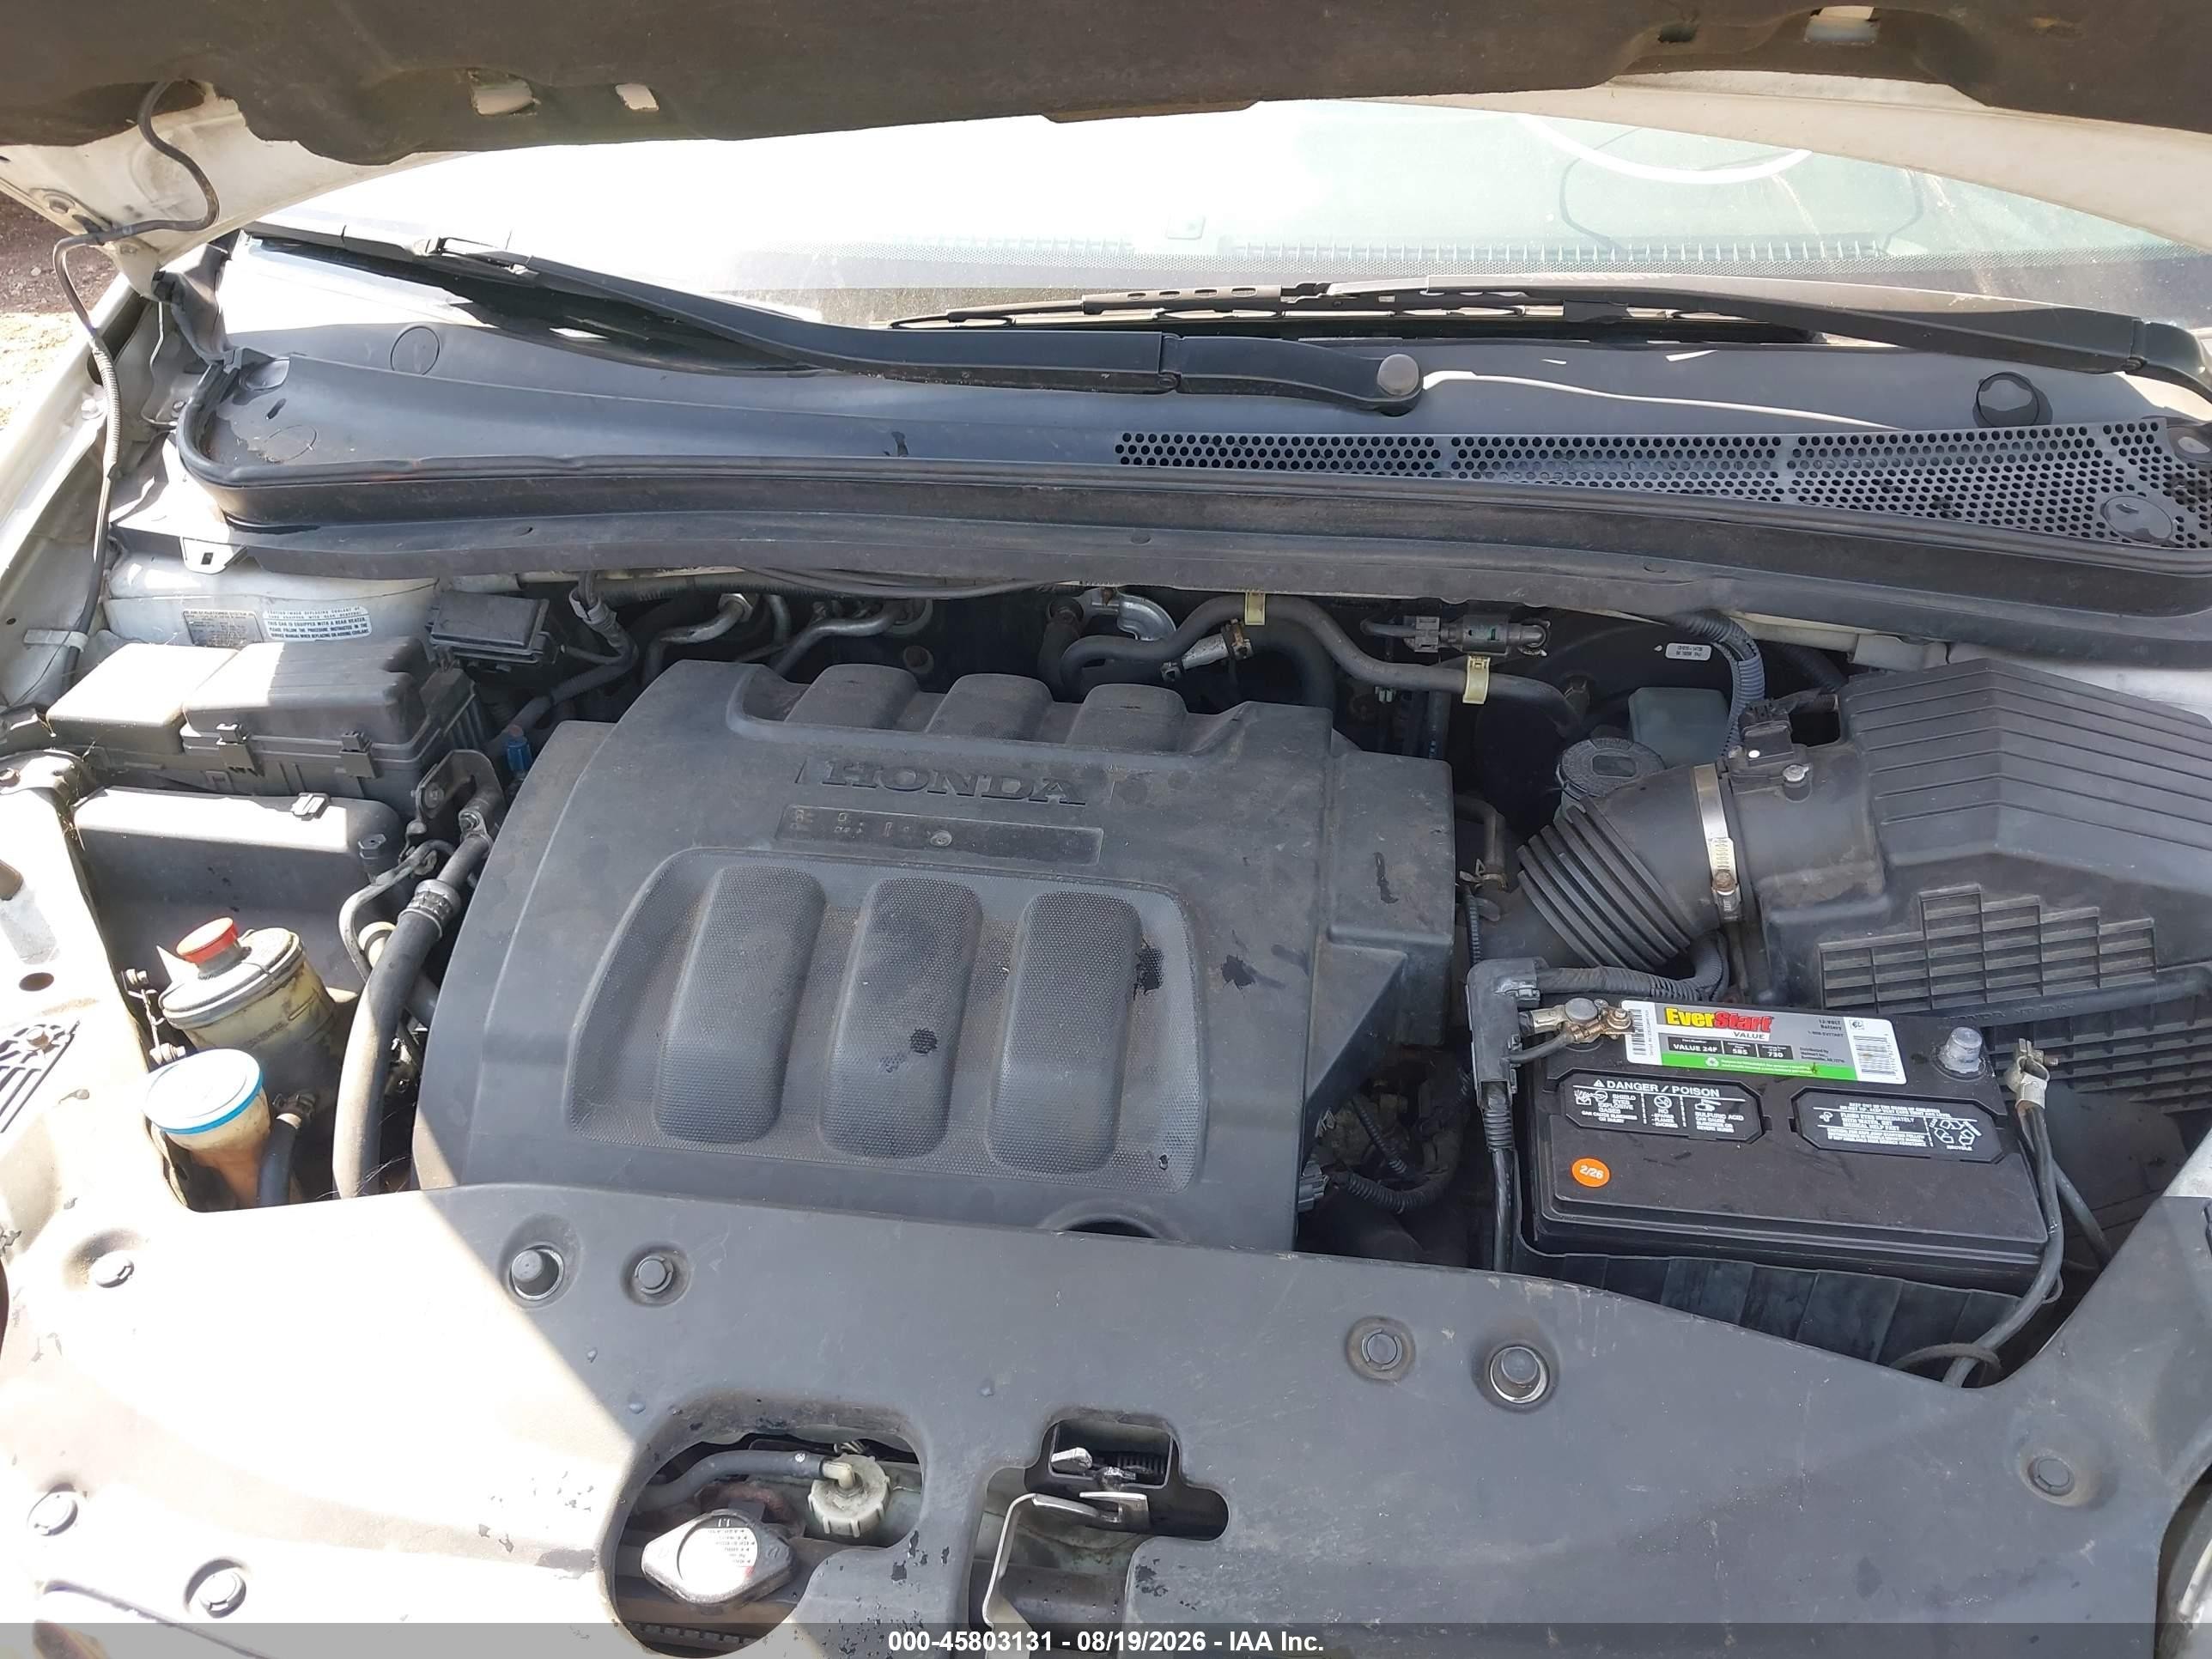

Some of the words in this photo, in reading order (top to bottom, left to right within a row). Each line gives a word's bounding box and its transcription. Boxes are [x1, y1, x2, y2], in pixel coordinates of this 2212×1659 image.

[822, 761, 1086, 805] HONDA
[1665, 1006, 1772, 1033] EverStart
[1733, 1031, 1766, 1040] VALUE
[1673, 1043, 1701, 1052] VALUE
[1607, 1080, 1659, 1093] DANGER
[1660, 1085, 1670, 1093] /
[1672, 1085, 1720, 1097] POISON
[1598, 1102, 1634, 1110] EXPLOSIVE
[1695, 1111, 1726, 1120] SULFURIC
[1580, 1165, 1604, 1179] 2/26
